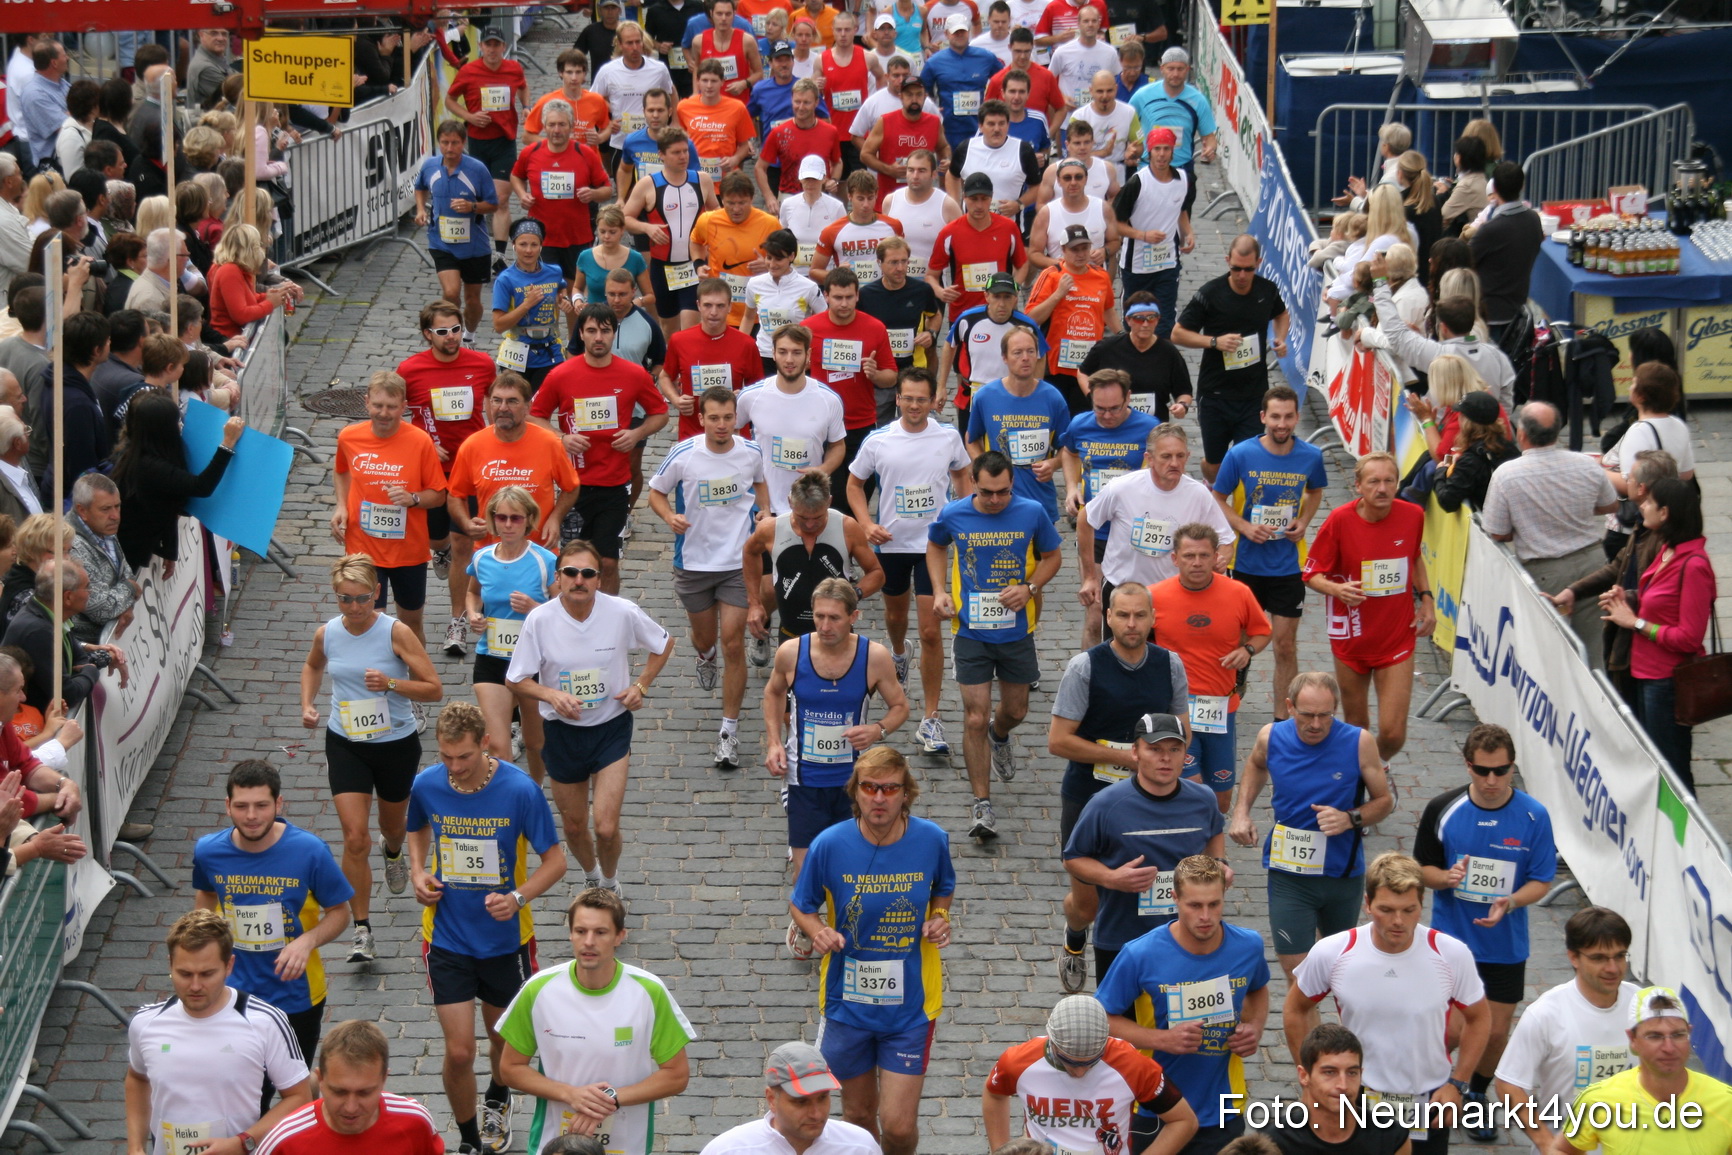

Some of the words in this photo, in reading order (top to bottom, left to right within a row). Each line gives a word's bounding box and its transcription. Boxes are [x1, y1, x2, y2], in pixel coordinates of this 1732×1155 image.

[253, 49, 345, 70] Schnupper-
[284, 71, 314, 86] lauf
[696, 121, 726, 129] Fischer
[899, 136, 927, 147] FILA
[551, 182, 572, 192] 2015
[450, 227, 465, 235] 120
[1153, 253, 1171, 263] 3574
[679, 270, 694, 280] 297
[857, 270, 878, 280] 2875
[1067, 329, 1096, 337] München
[834, 342, 853, 350] Andreas
[504, 349, 524, 362] 1105
[833, 351, 857, 361] 2568
[1237, 347, 1254, 359] 851
[704, 376, 727, 386] 2567
[437, 389, 463, 397] Alexander
[445, 399, 459, 409] 86
[591, 410, 611, 420] 859
[1003, 414, 1050, 424] NEUMARKTER
[1001, 421, 1041, 429] STADTLAUF
[1020, 433, 1037, 441] Martin
[1022, 442, 1045, 453] 3508
[1090, 442, 1139, 451] NEUMARKTER
[783, 449, 808, 459] 3864
[1087, 449, 1128, 457] STADTLAUF
[360, 460, 404, 472] Fischer
[490, 467, 533, 477] Fischer
[1248, 470, 1258, 478] 10.
[1257, 478, 1298, 487] STADTLAUF
[712, 483, 738, 496] 3830
[905, 486, 932, 496] Bernhard
[907, 496, 934, 508] 2125
[1264, 508, 1281, 516] Roland
[373, 515, 401, 527] 3593
[1145, 521, 1162, 531] Georg
[1263, 518, 1288, 528] 2930
[968, 531, 1025, 540] NEUMARKTER
[1144, 533, 1171, 545] 2975
[967, 539, 1014, 547] STADTLAUF
[1374, 562, 1389, 570] Fritz
[1379, 572, 1401, 584] 855
[982, 606, 1010, 617] 2597
[1351, 608, 1362, 637] MAX
[573, 673, 591, 682] Josef
[575, 683, 605, 696] 2333
[804, 708, 843, 720] Servidio
[1197, 708, 1223, 720] 2141
[353, 712, 385, 728] 1021
[817, 739, 847, 750] 6031
[431, 813, 442, 824] 10.
[443, 815, 510, 827] NEUMARKTER
[441, 825, 496, 837] STADTLAUF
[1286, 830, 1311, 842] Oswald
[454, 842, 479, 852] Tobias
[1291, 846, 1317, 860] 157
[466, 856, 485, 869] 35
[1472, 860, 1495, 871] Bernd
[214, 875, 225, 884] 10.
[227, 875, 300, 888] NEUMARKTER
[842, 874, 857, 883] 10.
[858, 872, 924, 883] NEUMARKTER
[1471, 874, 1506, 889] 2801
[225, 884, 285, 896] STADTLAUF
[855, 882, 913, 894] STADTLAUF
[236, 909, 258, 919] Peter
[243, 922, 273, 936] 718
[877, 925, 916, 934] 20.09.2009
[859, 964, 882, 974] Achim
[860, 977, 897, 990] 3376
[1187, 991, 1225, 1011] 3808
[1595, 1050, 1628, 1060] Gerhard
[1026, 1094, 1116, 1119] MERZ
[1026, 1106, 1096, 1129] Reisen
[175, 1127, 199, 1138] Heiko
